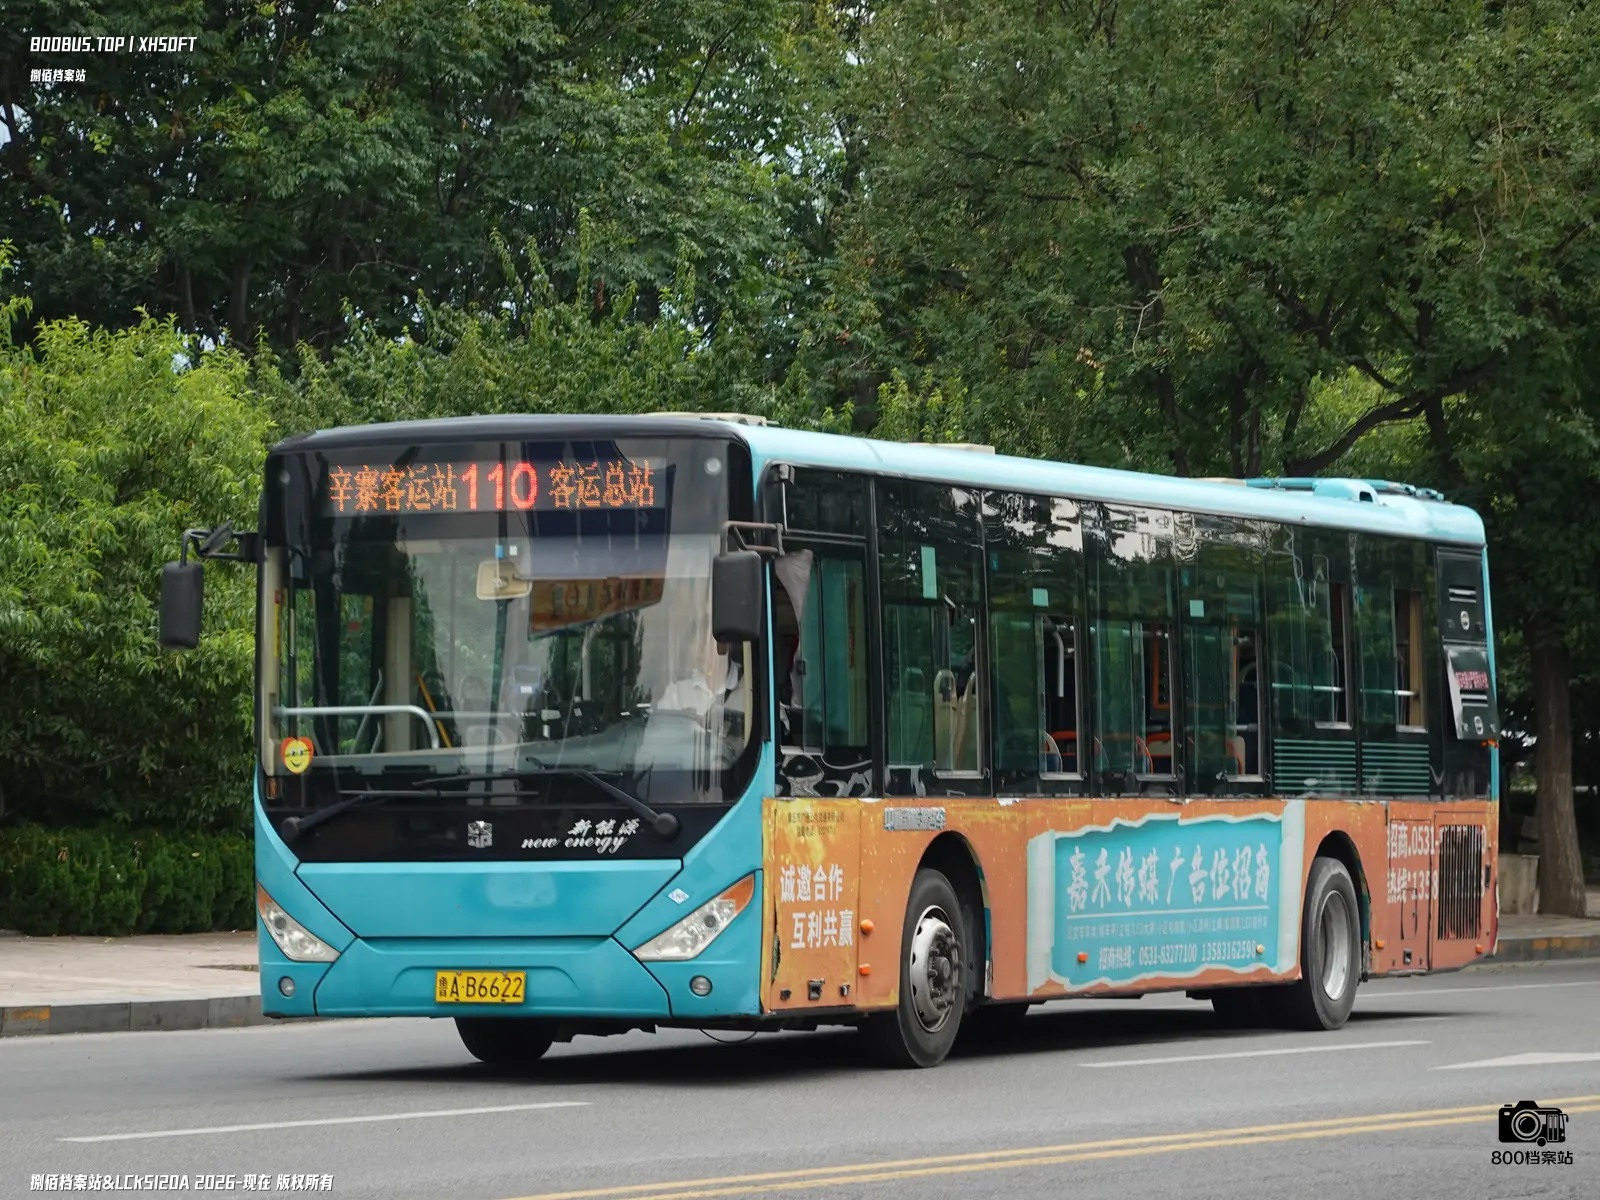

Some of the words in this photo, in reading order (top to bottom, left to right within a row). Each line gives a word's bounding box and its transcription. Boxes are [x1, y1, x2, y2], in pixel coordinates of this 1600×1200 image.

[329, 464, 457, 512] 辛寨客运站
[461, 463, 538, 509] 110
[549, 460, 655, 508] 客运总站
[521, 838, 561, 849] new
[564, 836, 629, 854] energy
[780, 863, 843, 903] 诚邀合作
[791, 908, 854, 949] 互利共赢
